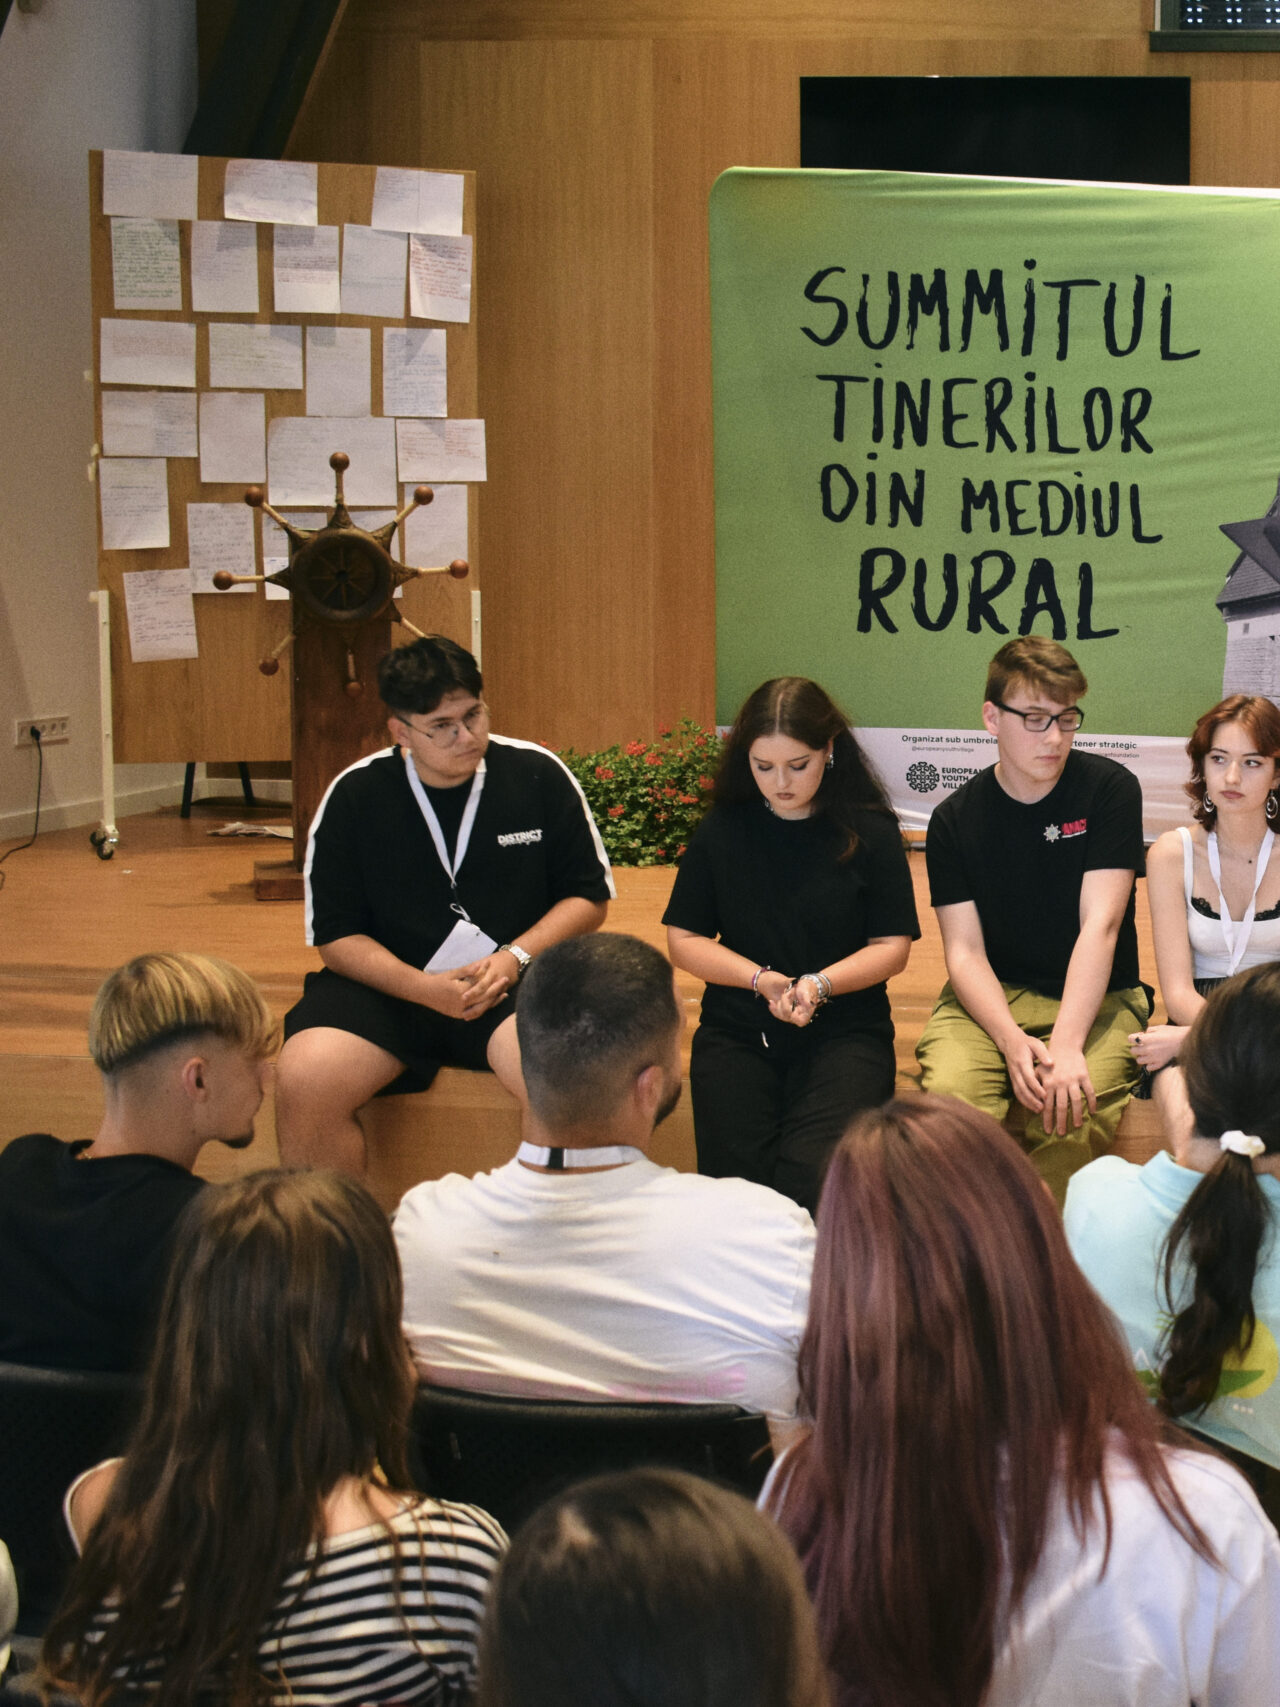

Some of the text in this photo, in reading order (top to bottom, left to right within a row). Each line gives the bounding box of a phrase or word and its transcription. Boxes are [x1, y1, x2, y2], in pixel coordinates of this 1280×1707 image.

[800, 258, 1201, 361] SUMMITUL
[816, 362, 1154, 454] TINERILOR
[818, 452, 1163, 544] DIN MEDIUL
[856, 547, 1120, 641] RURAL
[902, 735, 943, 744] Organizat
[1099, 741, 1137, 750] strategic
